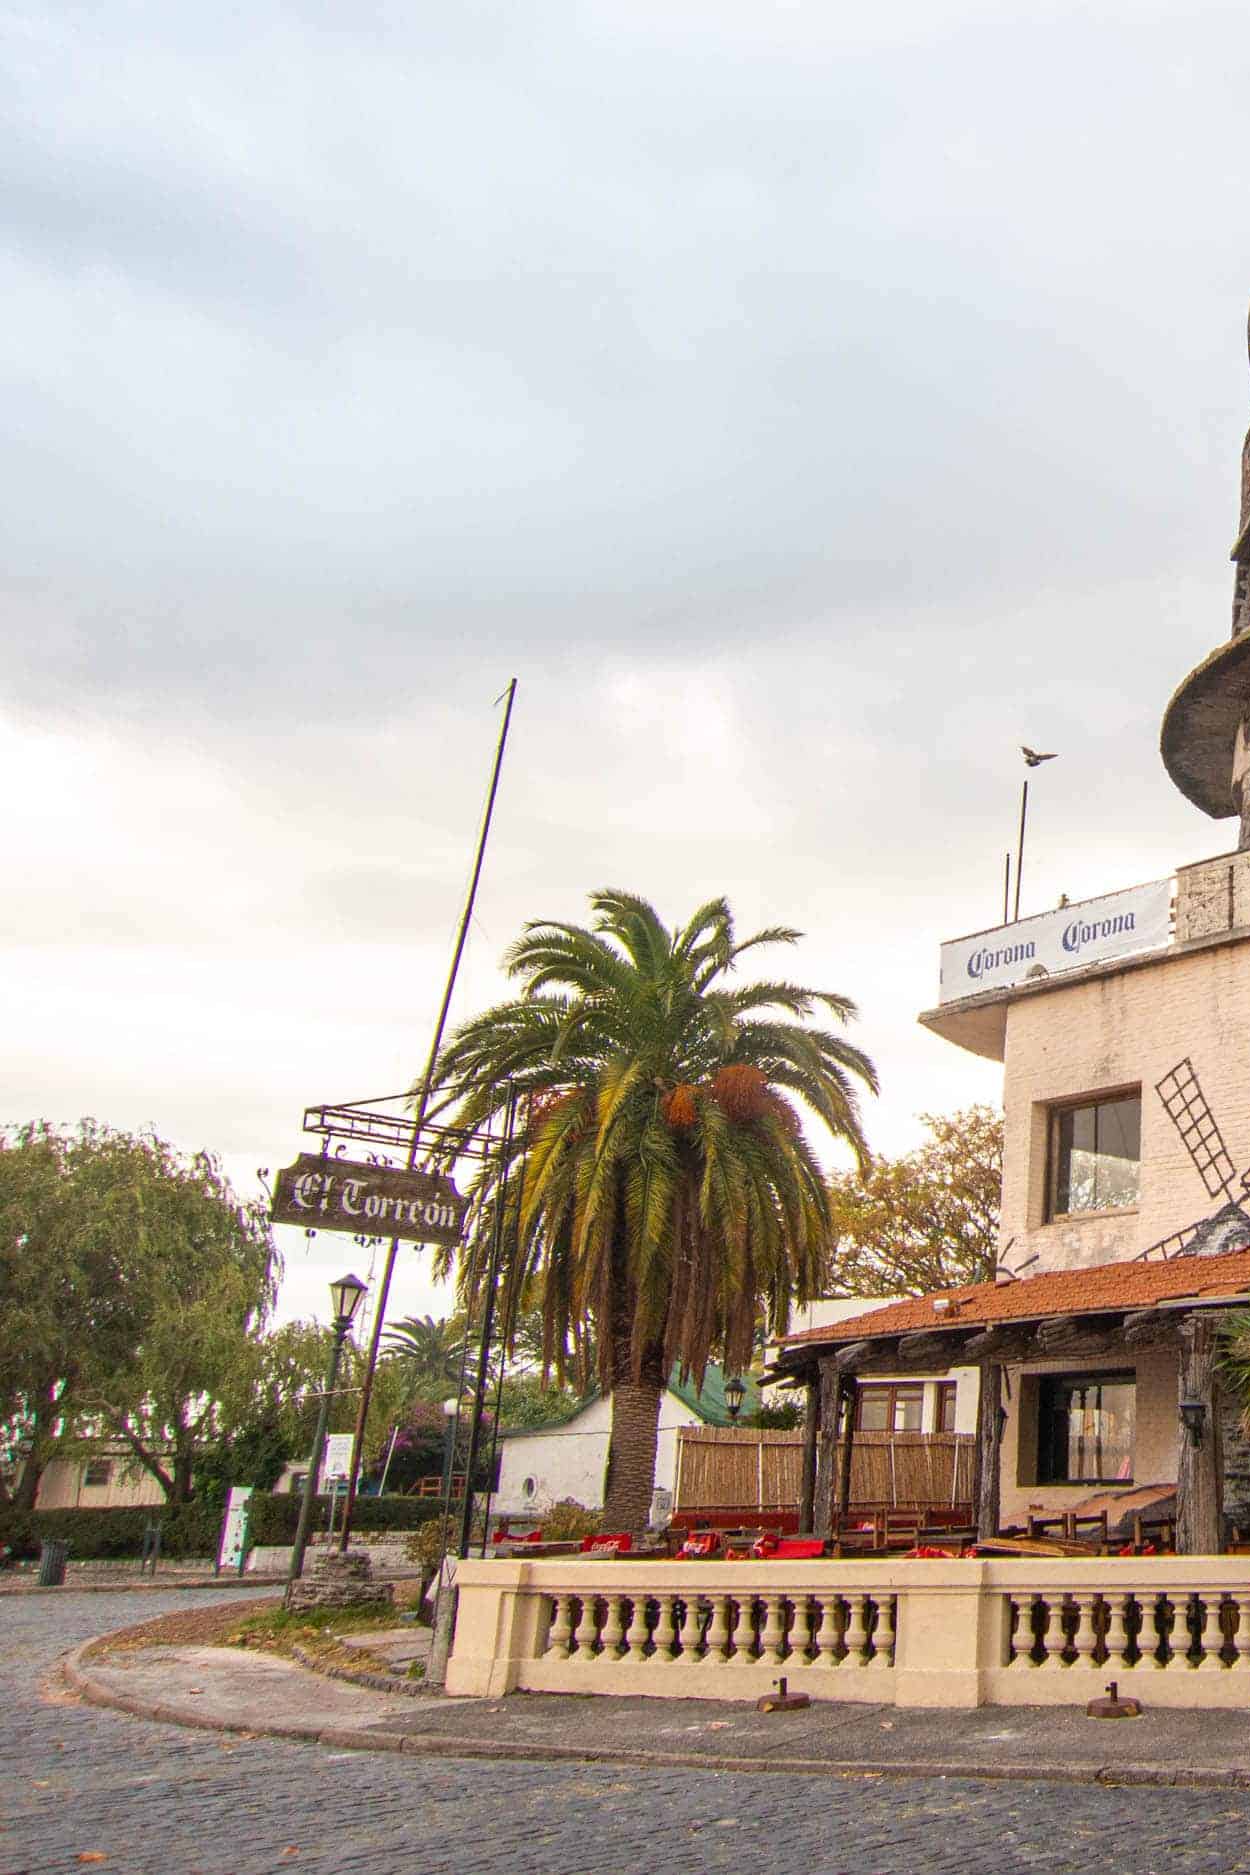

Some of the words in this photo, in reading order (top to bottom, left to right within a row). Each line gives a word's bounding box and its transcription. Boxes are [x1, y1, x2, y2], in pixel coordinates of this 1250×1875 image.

[967, 942, 1036, 978] Corona
[1062, 911, 1135, 953] Corona
[293, 1172, 336, 1216] El
[342, 1177, 456, 1228] Torreón
